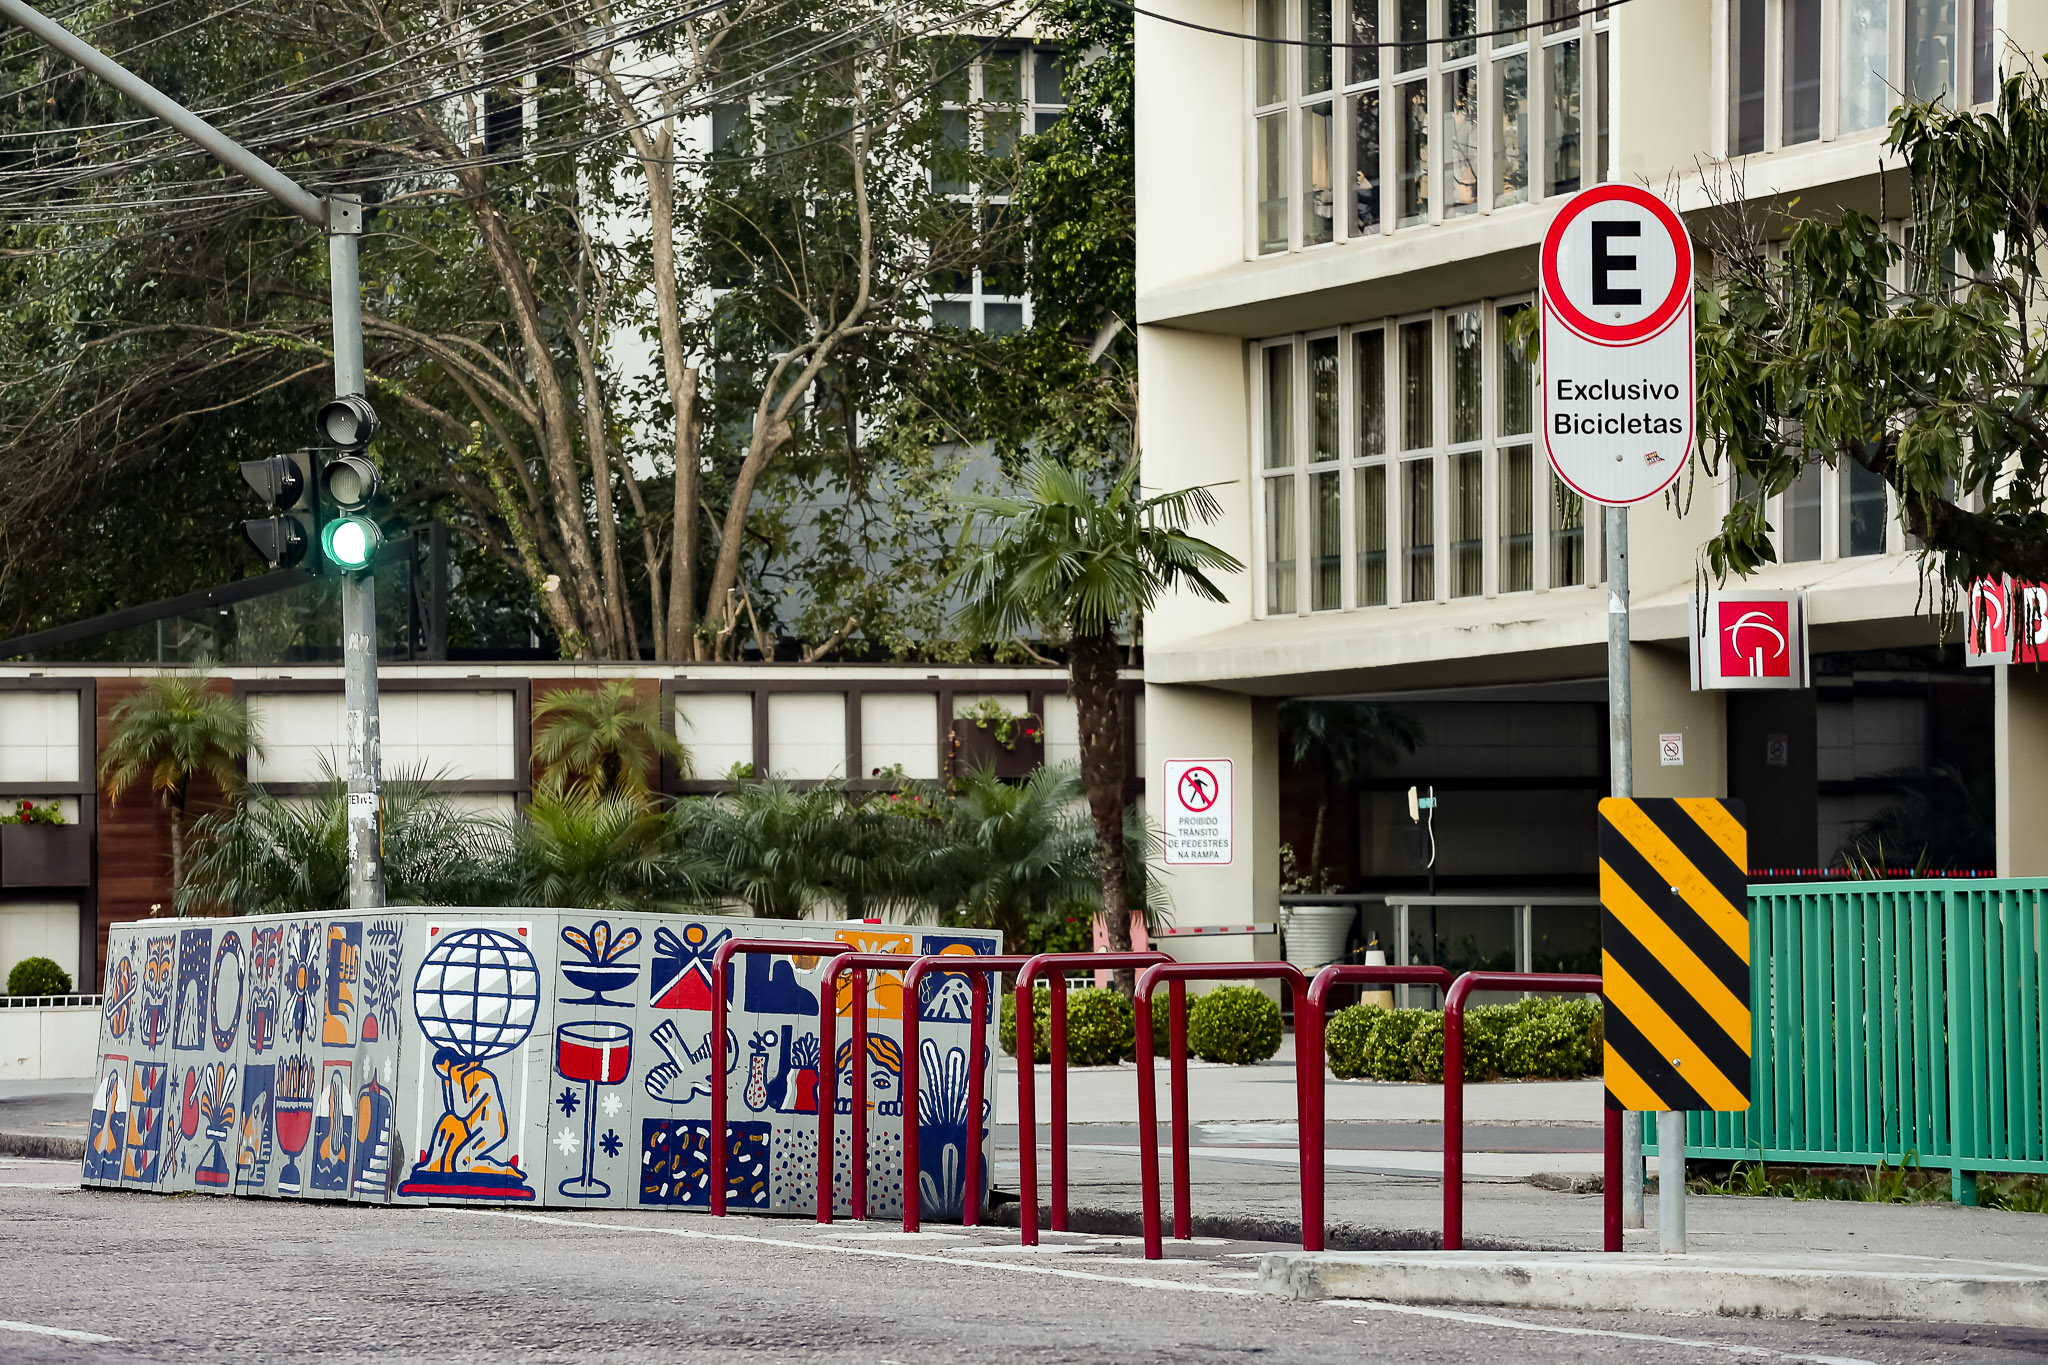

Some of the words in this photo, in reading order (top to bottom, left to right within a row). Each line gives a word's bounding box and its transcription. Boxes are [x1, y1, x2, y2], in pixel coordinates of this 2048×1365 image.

[1591, 220, 1642, 305] E
[1557, 379, 1680, 401] Exclusivo
[1554, 412, 1683, 435] Bicicletas
[1178, 816, 1218, 825] PROIBIDO
[1178, 827, 1219, 837] TRÂNSITO
[1168, 839, 1179, 848] DE
[1181, 839, 1229, 848] PEDESTRES
[1178, 850, 1189, 859] NA
[1191, 850, 1219, 859] RAMPA
